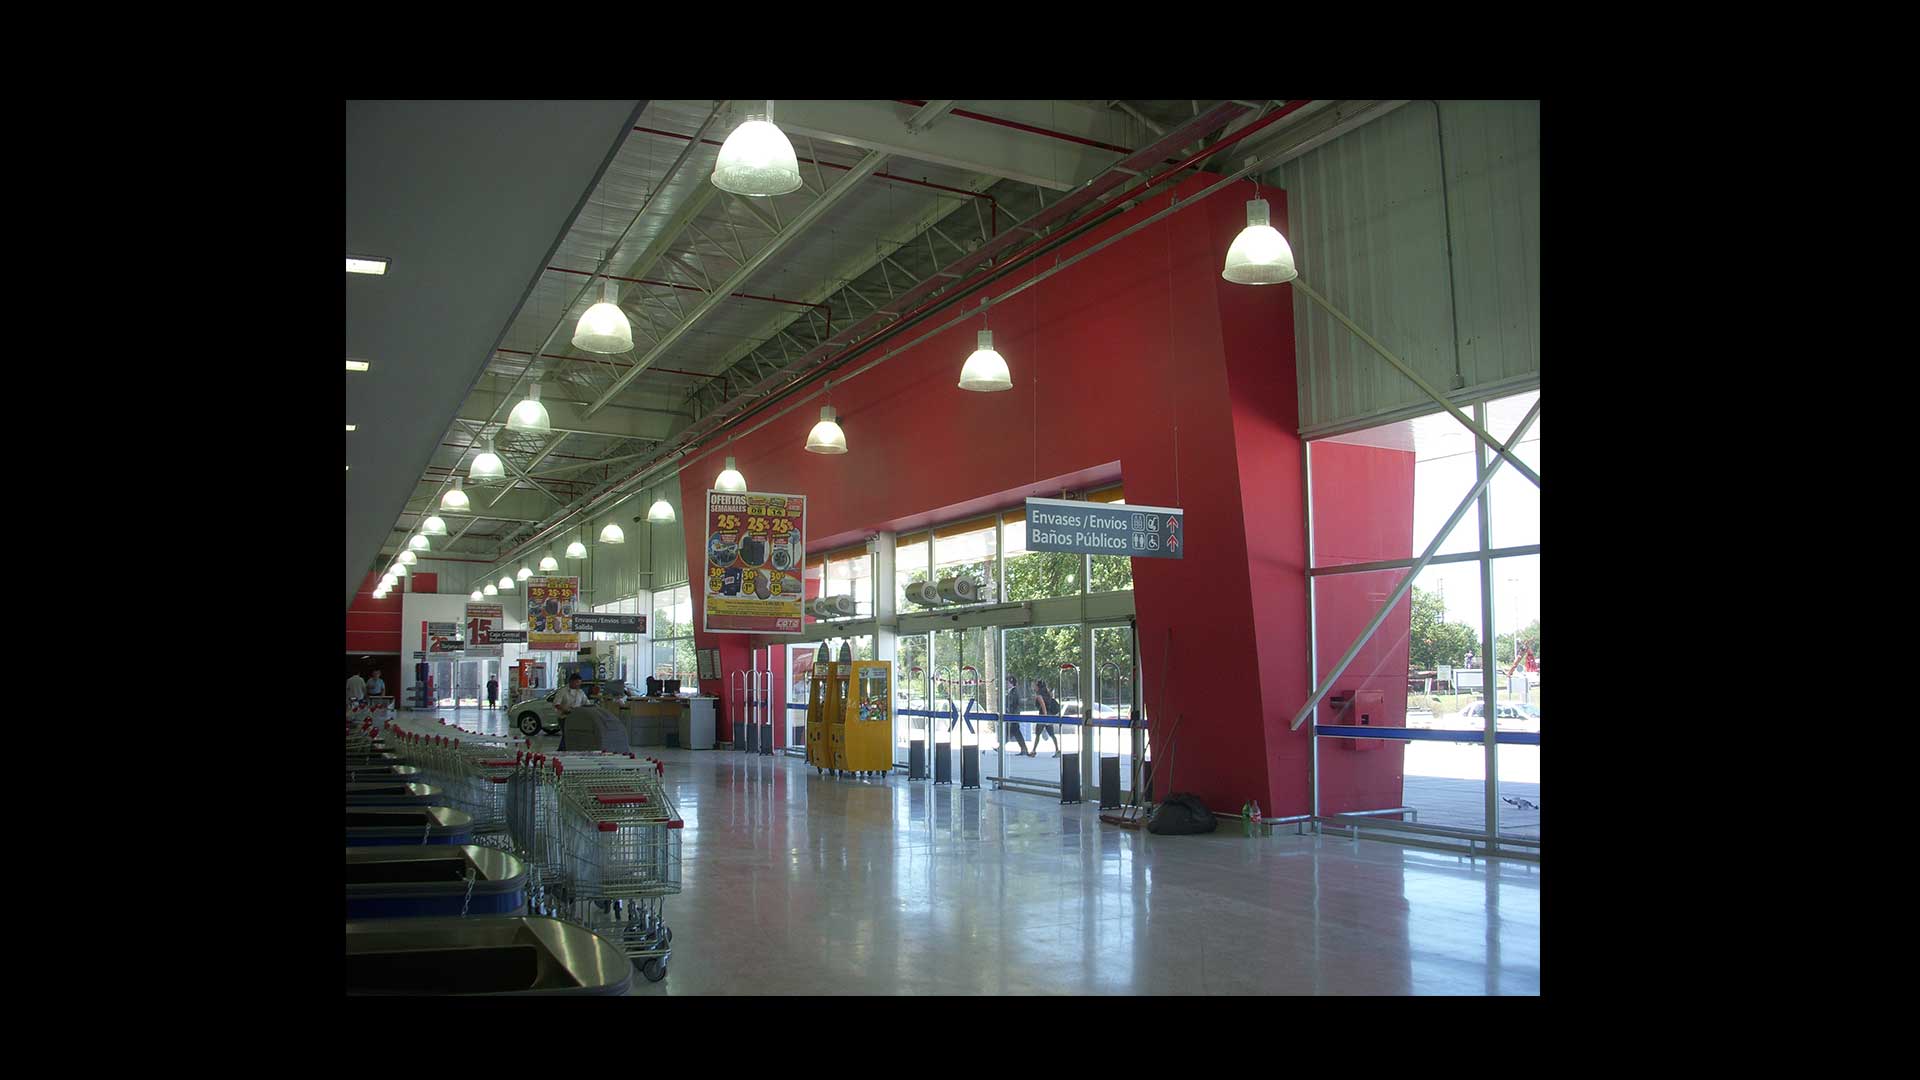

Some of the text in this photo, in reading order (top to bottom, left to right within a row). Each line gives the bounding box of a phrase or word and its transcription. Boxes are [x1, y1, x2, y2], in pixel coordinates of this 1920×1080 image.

[711, 494, 746, 505] OFERTAS
[1032, 510, 1081, 527] Envases
[1032, 529, 1127, 549] Baños Públicos
